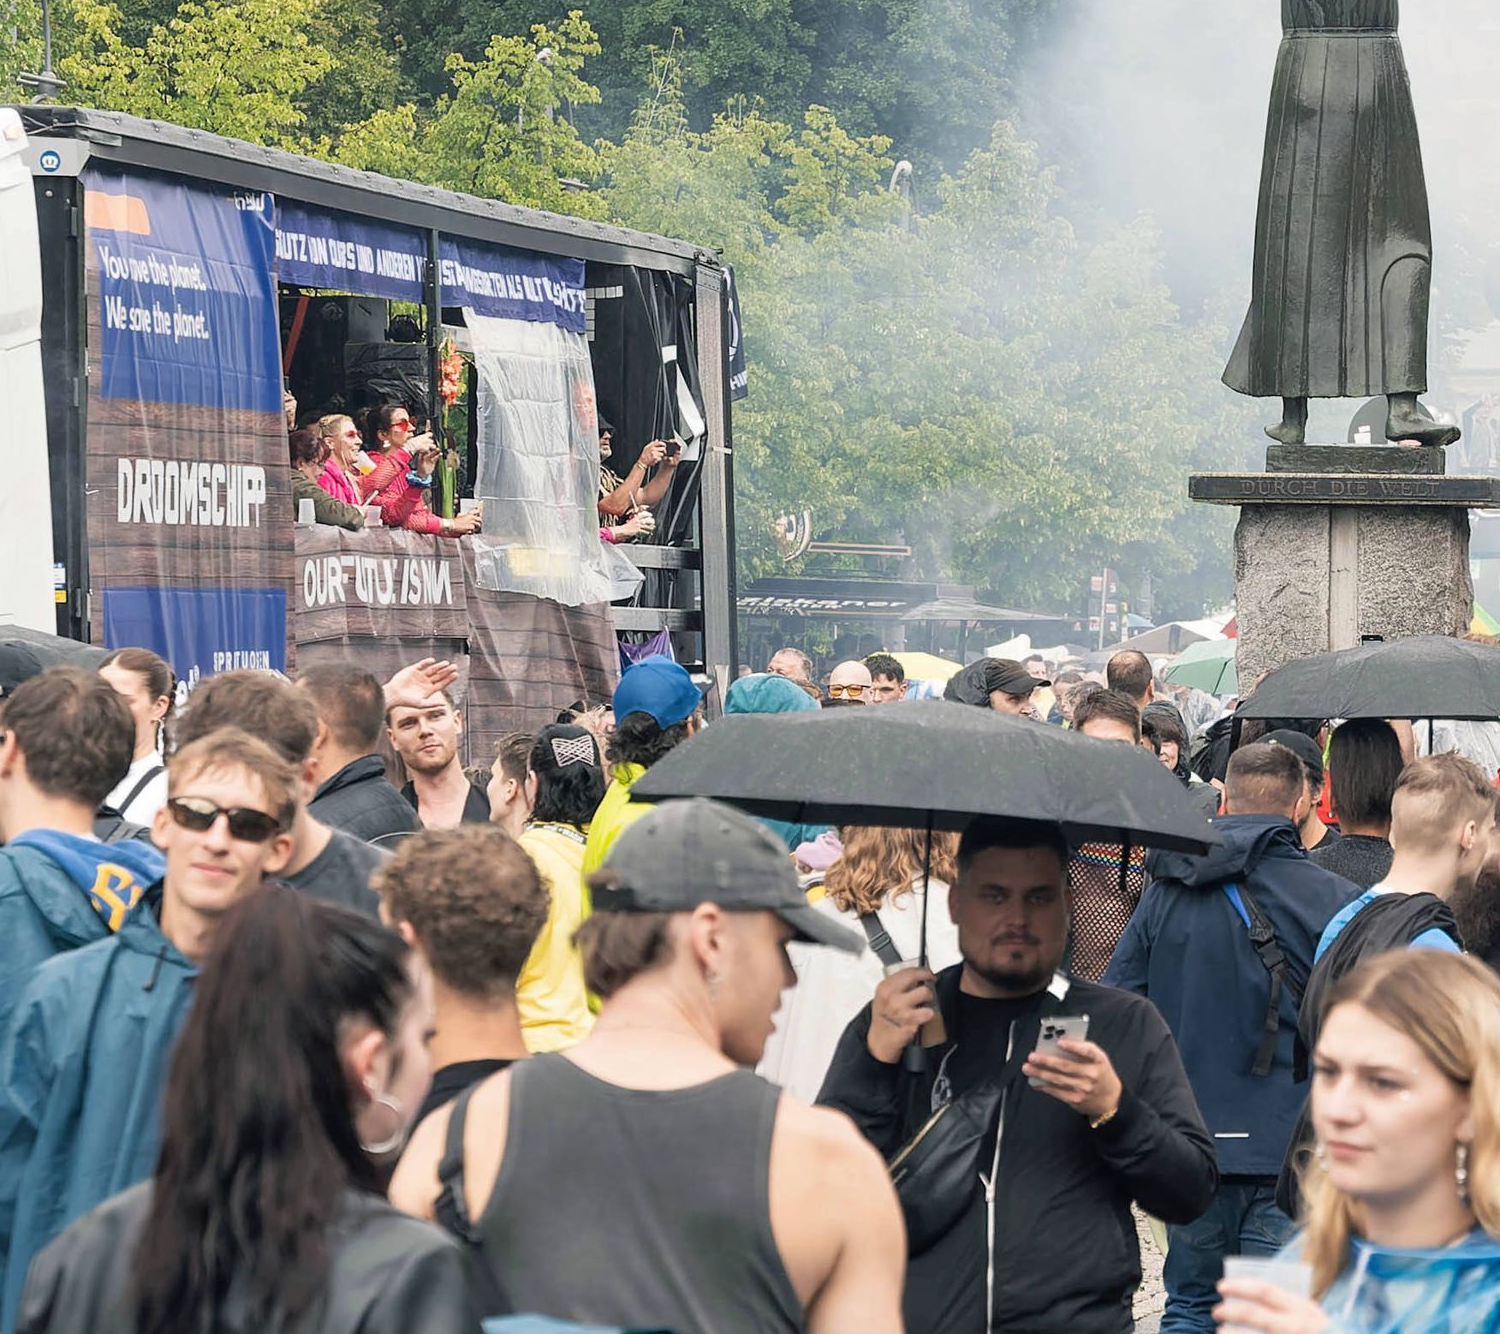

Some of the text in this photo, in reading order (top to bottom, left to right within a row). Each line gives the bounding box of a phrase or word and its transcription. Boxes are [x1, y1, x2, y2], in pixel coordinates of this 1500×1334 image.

[99, 245, 129, 279] You
[105, 296, 126, 329] We
[152, 302, 171, 336] the
[1240, 479, 1440, 497] DURCH DIE WELT
